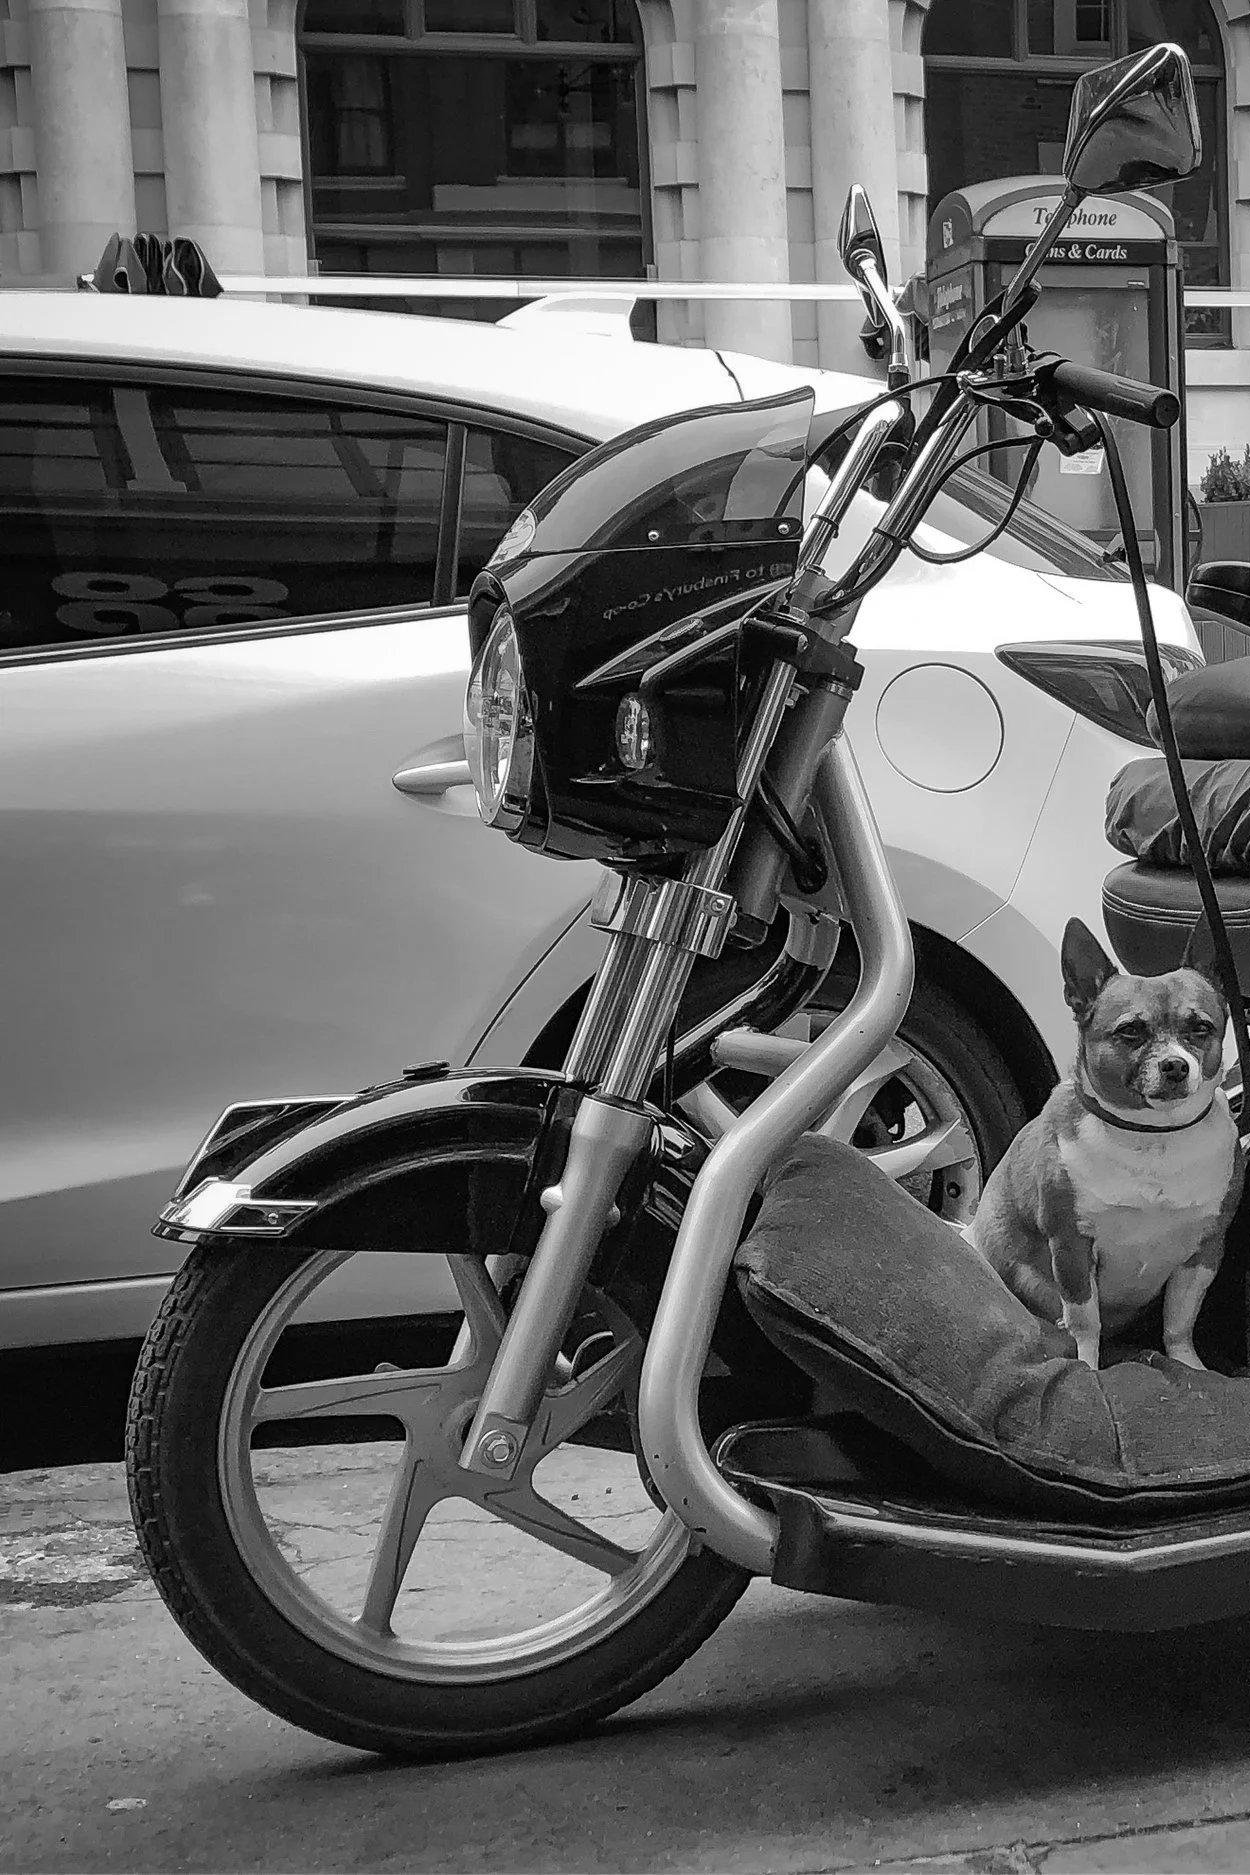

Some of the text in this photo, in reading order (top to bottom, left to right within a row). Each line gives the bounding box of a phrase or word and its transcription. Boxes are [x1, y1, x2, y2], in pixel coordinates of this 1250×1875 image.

[1033, 207, 1118, 229] Tephone
[1068, 243, 1082, 259] &
[1084, 243, 1128, 260] Cards
